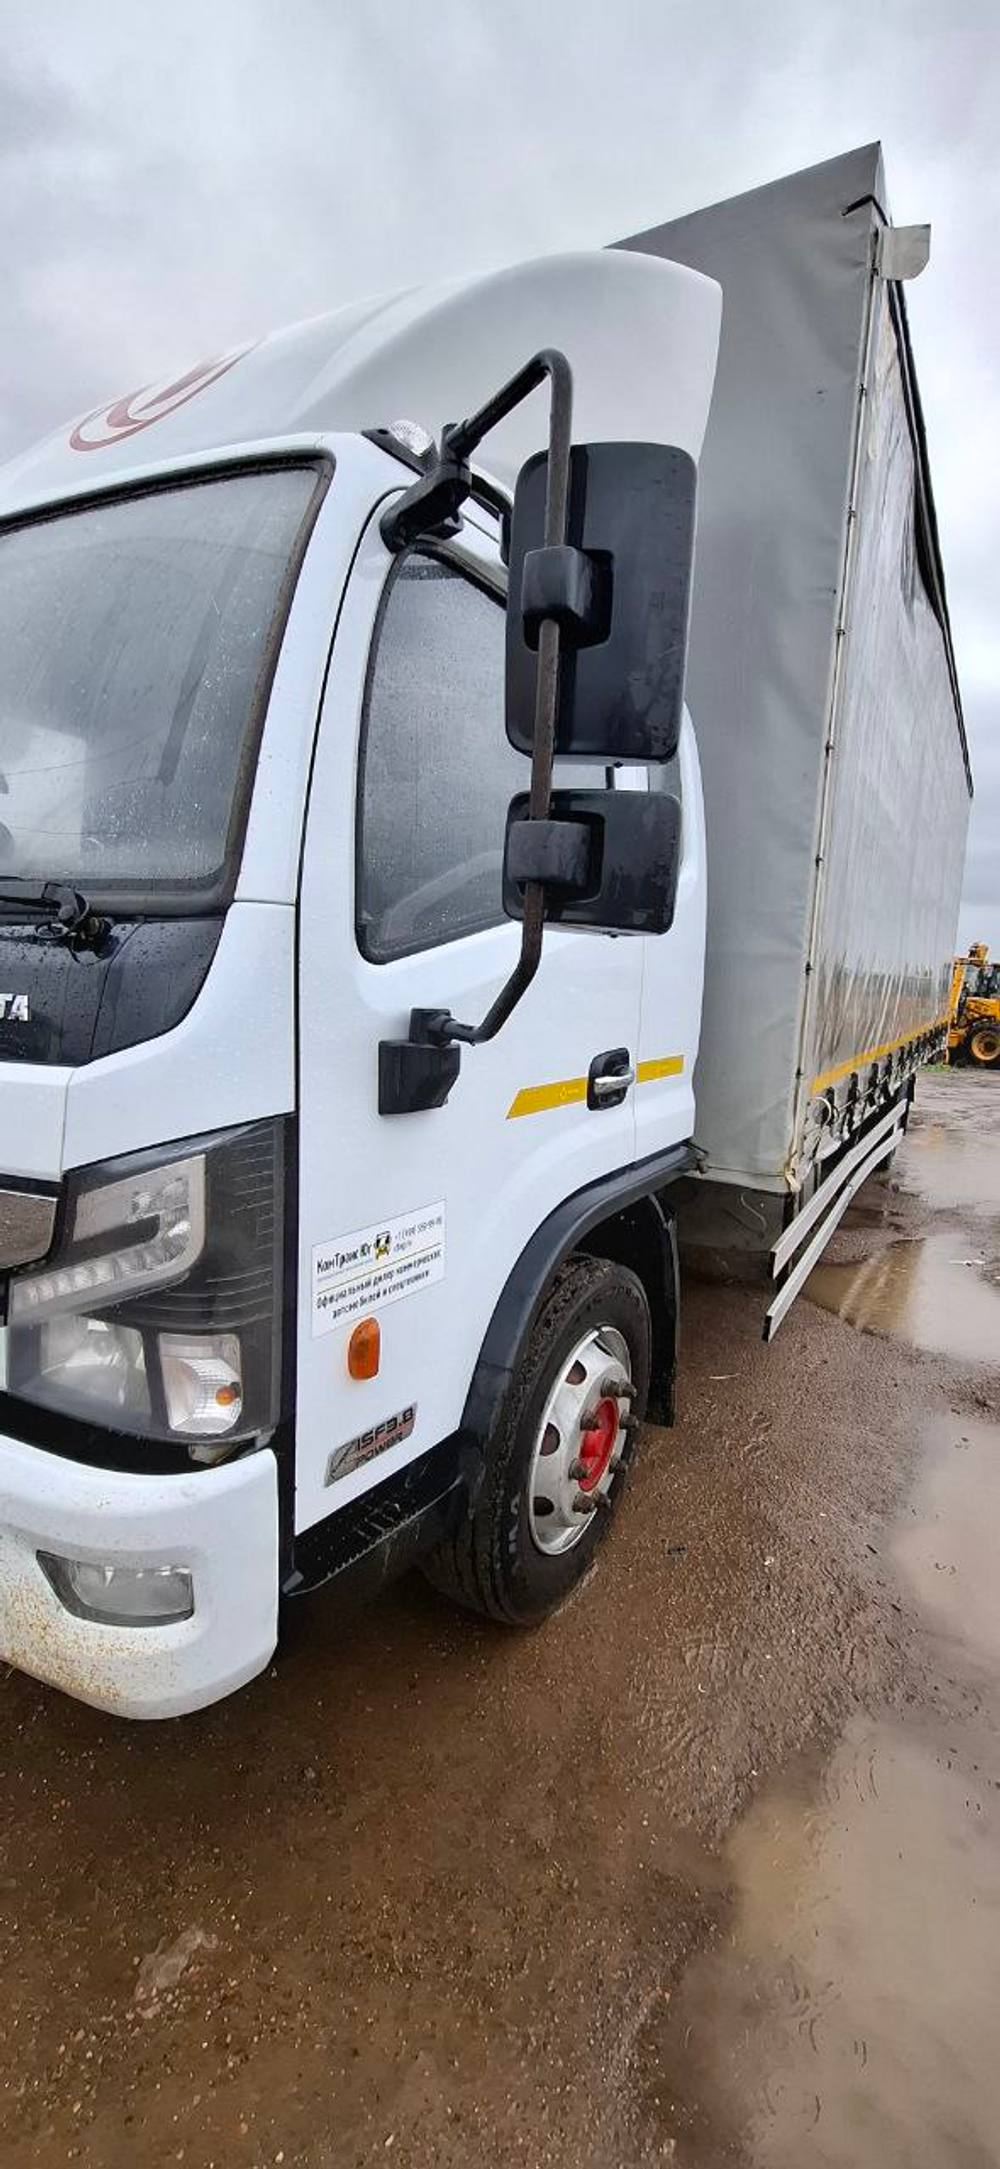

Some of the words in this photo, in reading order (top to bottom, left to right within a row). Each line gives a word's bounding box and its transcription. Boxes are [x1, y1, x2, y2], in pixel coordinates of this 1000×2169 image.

[317, 1280, 372, 1309] Официальный
[373, 1270, 395, 1287] дилер
[396, 1250, 441, 1274] коммерческих
[332, 1291, 381, 1319] автомобилей
[388, 1269, 430, 1294] спецтехники
[356, 1431, 404, 1468] POWER
[357, 1406, 414, 1451] ISF3.8
